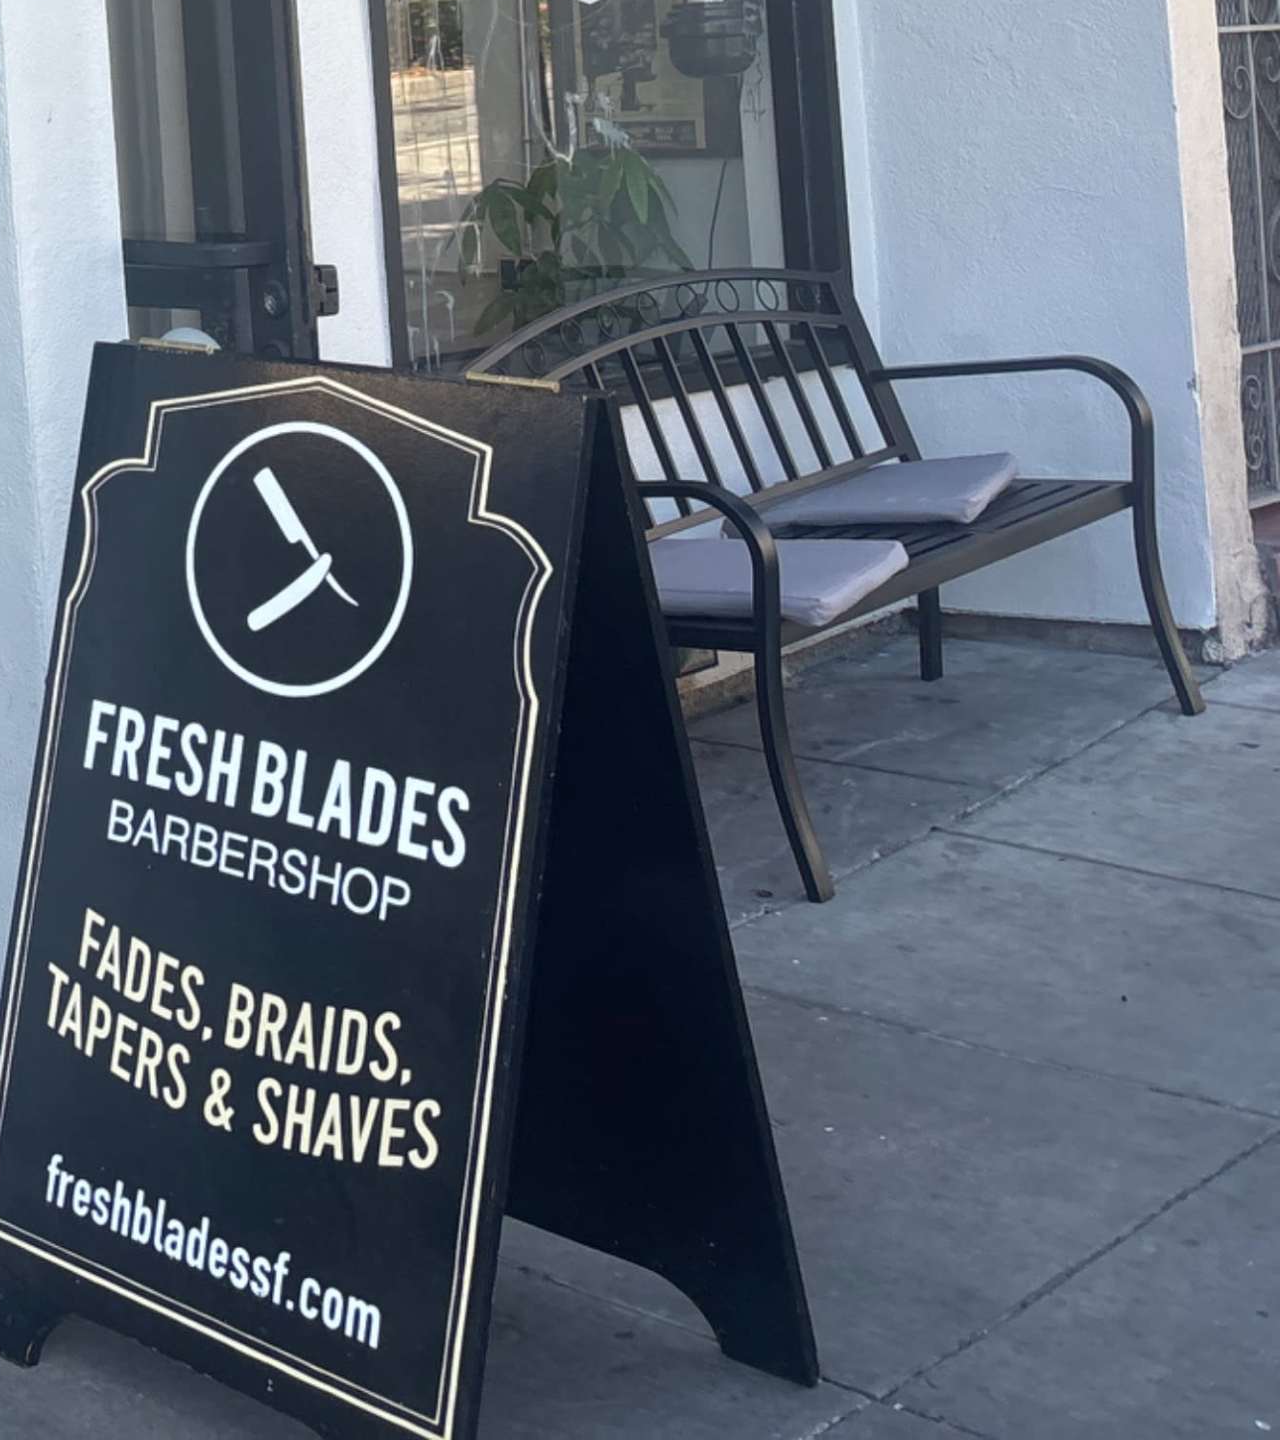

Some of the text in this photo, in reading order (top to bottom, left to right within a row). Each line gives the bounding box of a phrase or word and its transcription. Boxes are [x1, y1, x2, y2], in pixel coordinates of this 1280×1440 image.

[83, 699, 470, 868] FRESH BLADES
[107, 799, 412, 921] BARBERSHOP
[46, 962, 441, 1169] TAPERS & SHAVES
[79, 907, 412, 1086] FADES, BRAIDS,
[45, 1153, 381, 1349] freshbladessf.com
